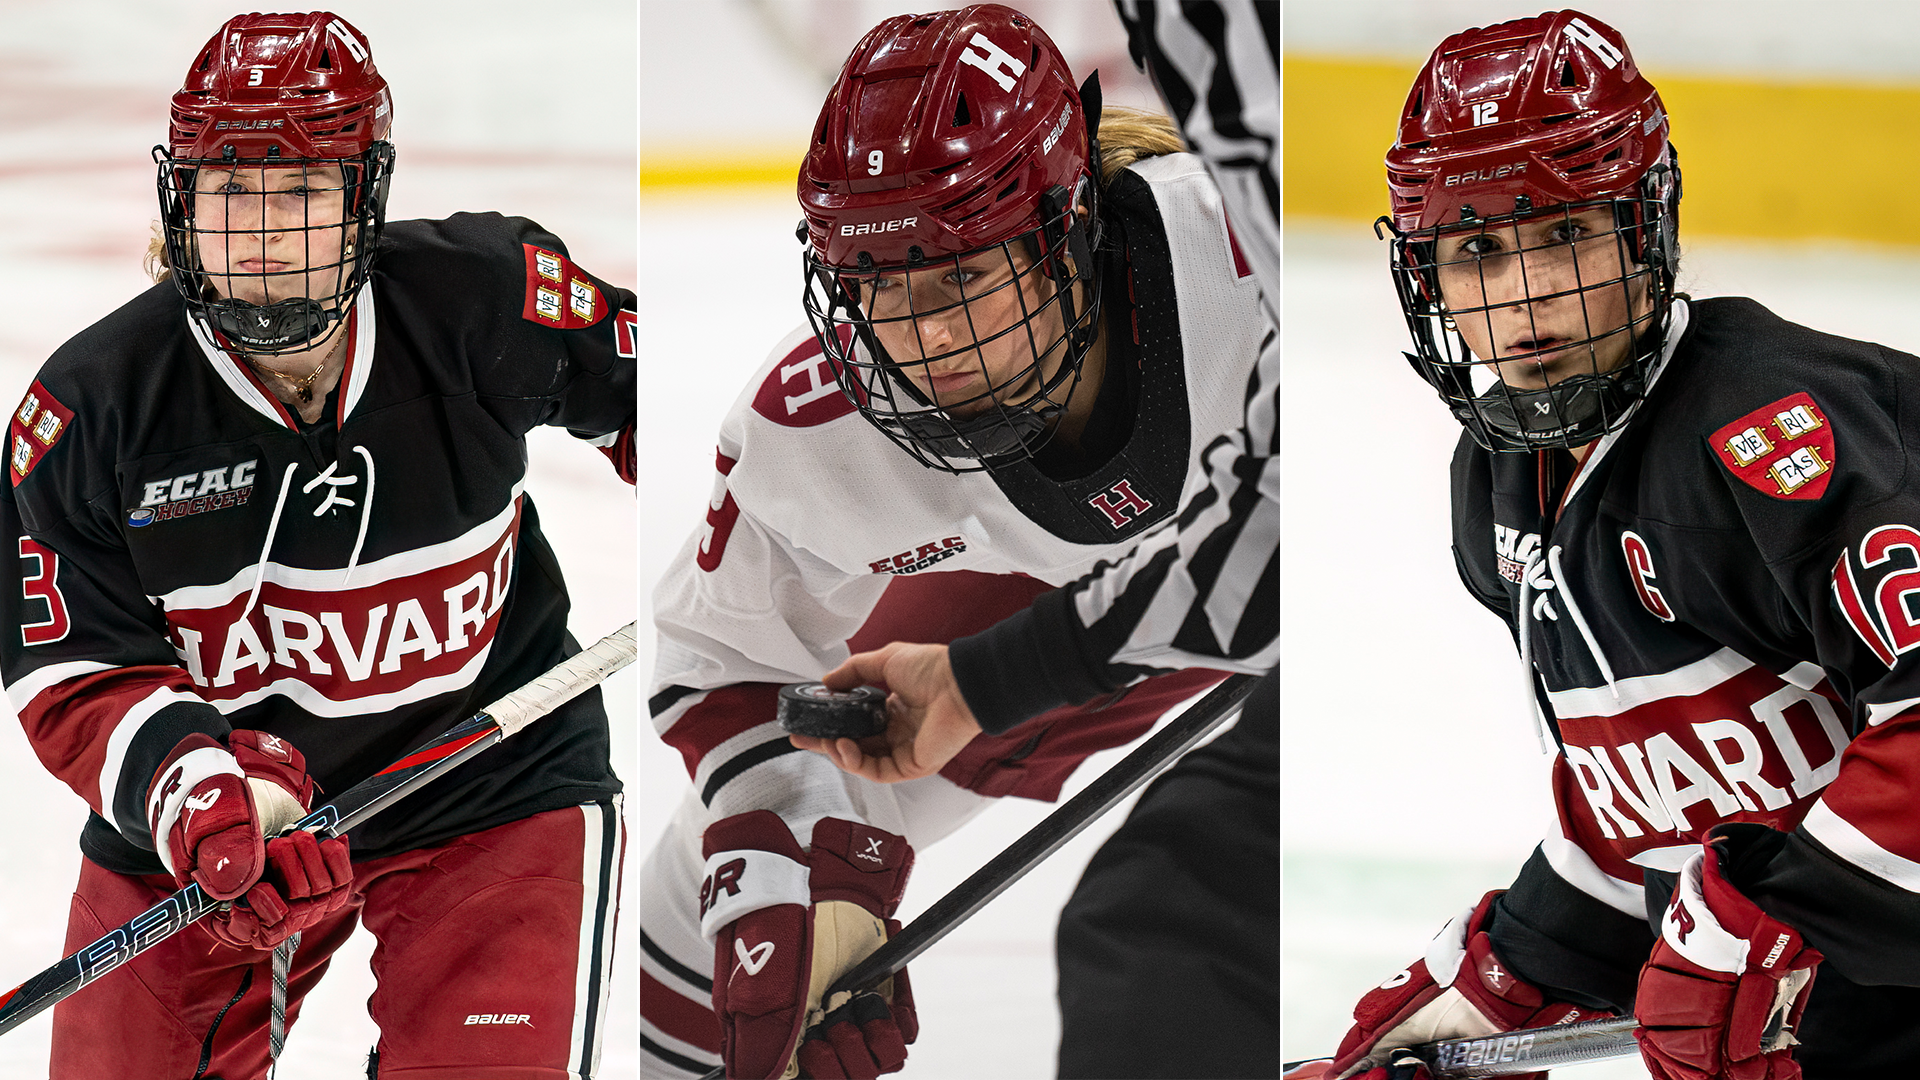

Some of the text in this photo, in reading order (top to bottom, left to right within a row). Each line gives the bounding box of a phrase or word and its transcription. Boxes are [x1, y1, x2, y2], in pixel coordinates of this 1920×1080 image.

[247, 68, 264, 87] 3
[958, 31, 1027, 94] H
[1472, 100, 1500, 127] 12
[867, 150, 884, 176] 9
[1444, 161, 1529, 188] BAUER
[840, 216, 919, 237] BAUER
[141, 459, 258, 507] ECAC
[155, 485, 254, 523] HOCKEY
[1088, 478, 1153, 530] H
[868, 536, 965, 574] ECAC
[18, 535, 71, 647] 3
[1621, 530, 1676, 621] C
[165, 532, 514, 688] HARVARD
[1831, 524, 1920, 671] 12
[1562, 683, 1851, 840] RVARD
[1762, 932, 1791, 968] CRIMSON
[464, 1013, 535, 1029] BAUER
[1451, 1033, 1536, 1067] BAUER
